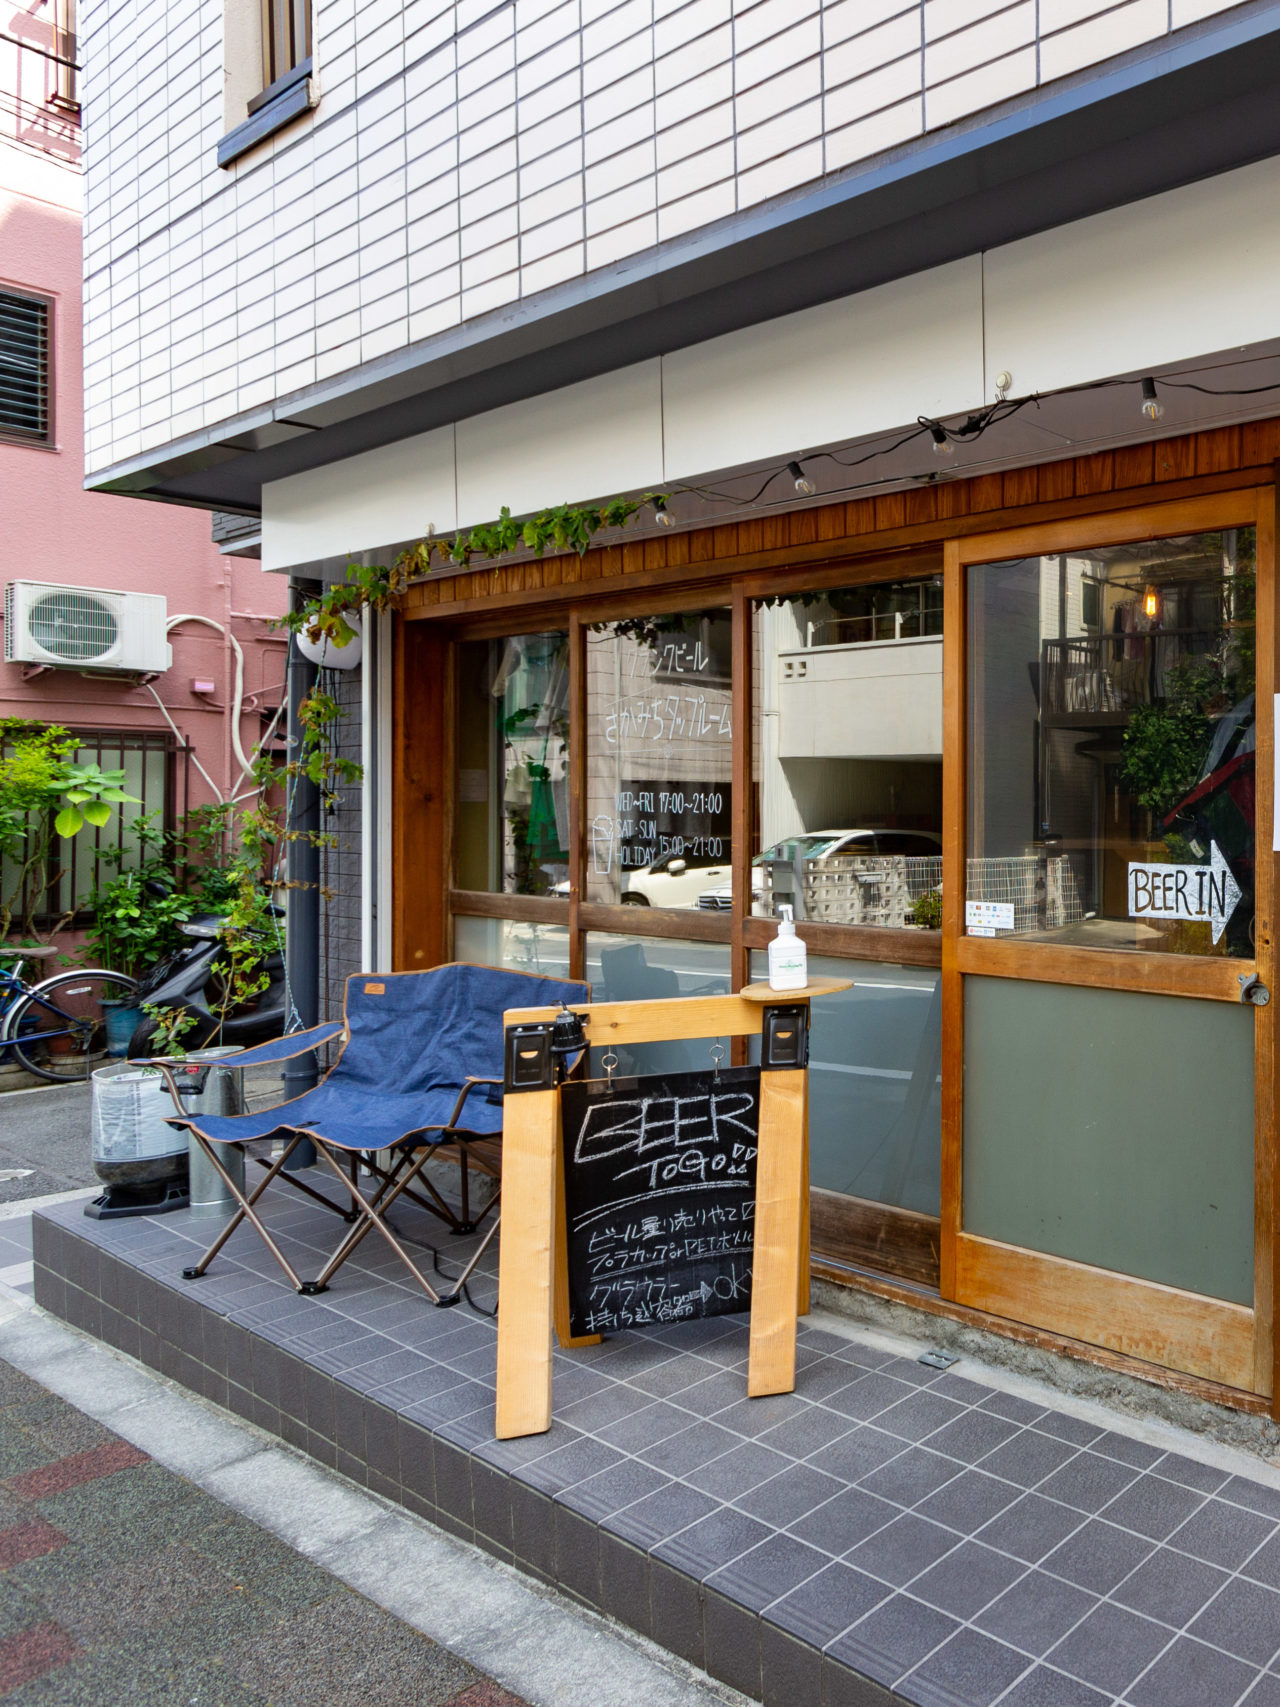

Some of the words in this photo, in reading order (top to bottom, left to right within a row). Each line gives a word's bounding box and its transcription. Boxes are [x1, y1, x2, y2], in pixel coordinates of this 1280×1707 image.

[606, 695, 732, 742] さかみちタップルーム
[615, 846, 656, 866] HOLIDAY
[1129, 868, 1192, 916] BEER
[1195, 870, 1227, 917] IN
[574, 1092, 757, 1164] BEER
[590, 1277, 680, 1308] グラウラー
